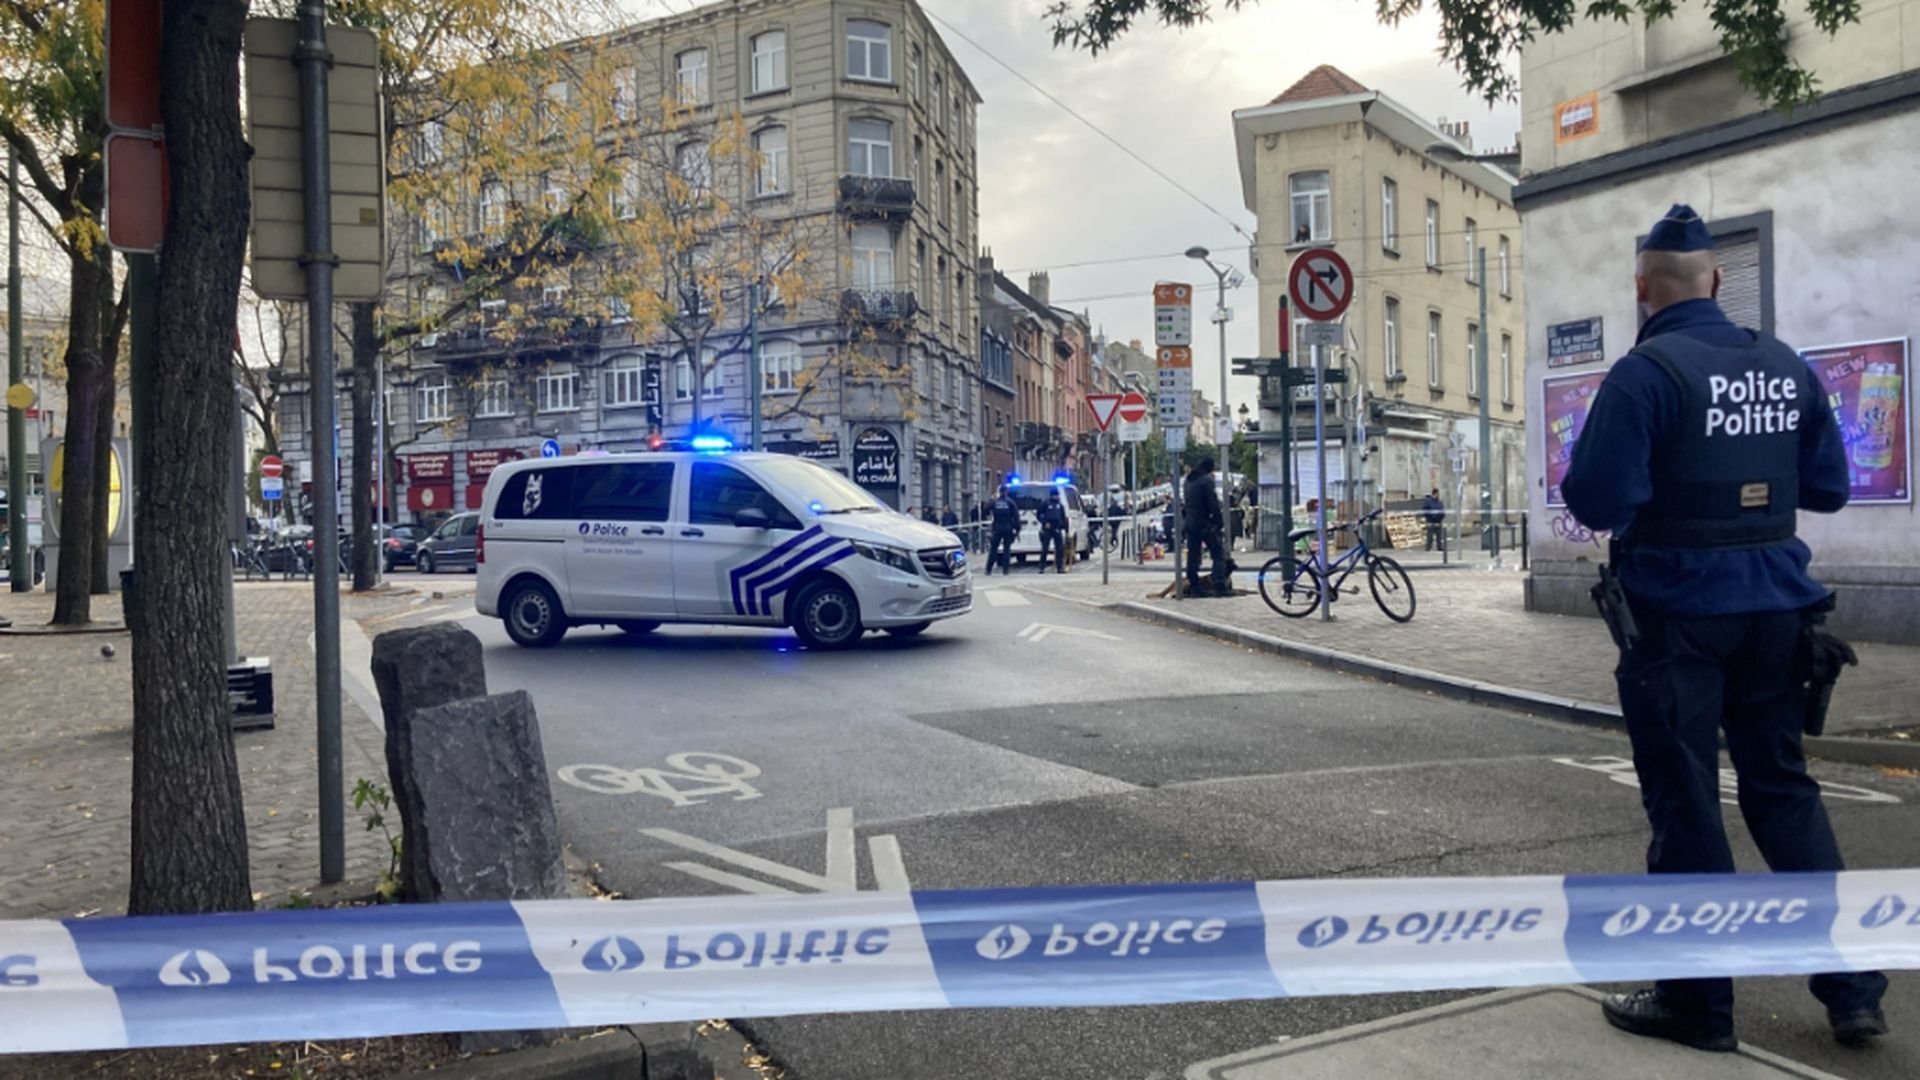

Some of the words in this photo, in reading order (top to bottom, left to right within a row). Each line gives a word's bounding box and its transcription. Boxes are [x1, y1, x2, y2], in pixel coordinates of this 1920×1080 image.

[1825, 355, 1866, 381] NEW
[1709, 371, 1797, 404] Police
[1706, 402, 1800, 437] Politie
[593, 522, 629, 537] Police
